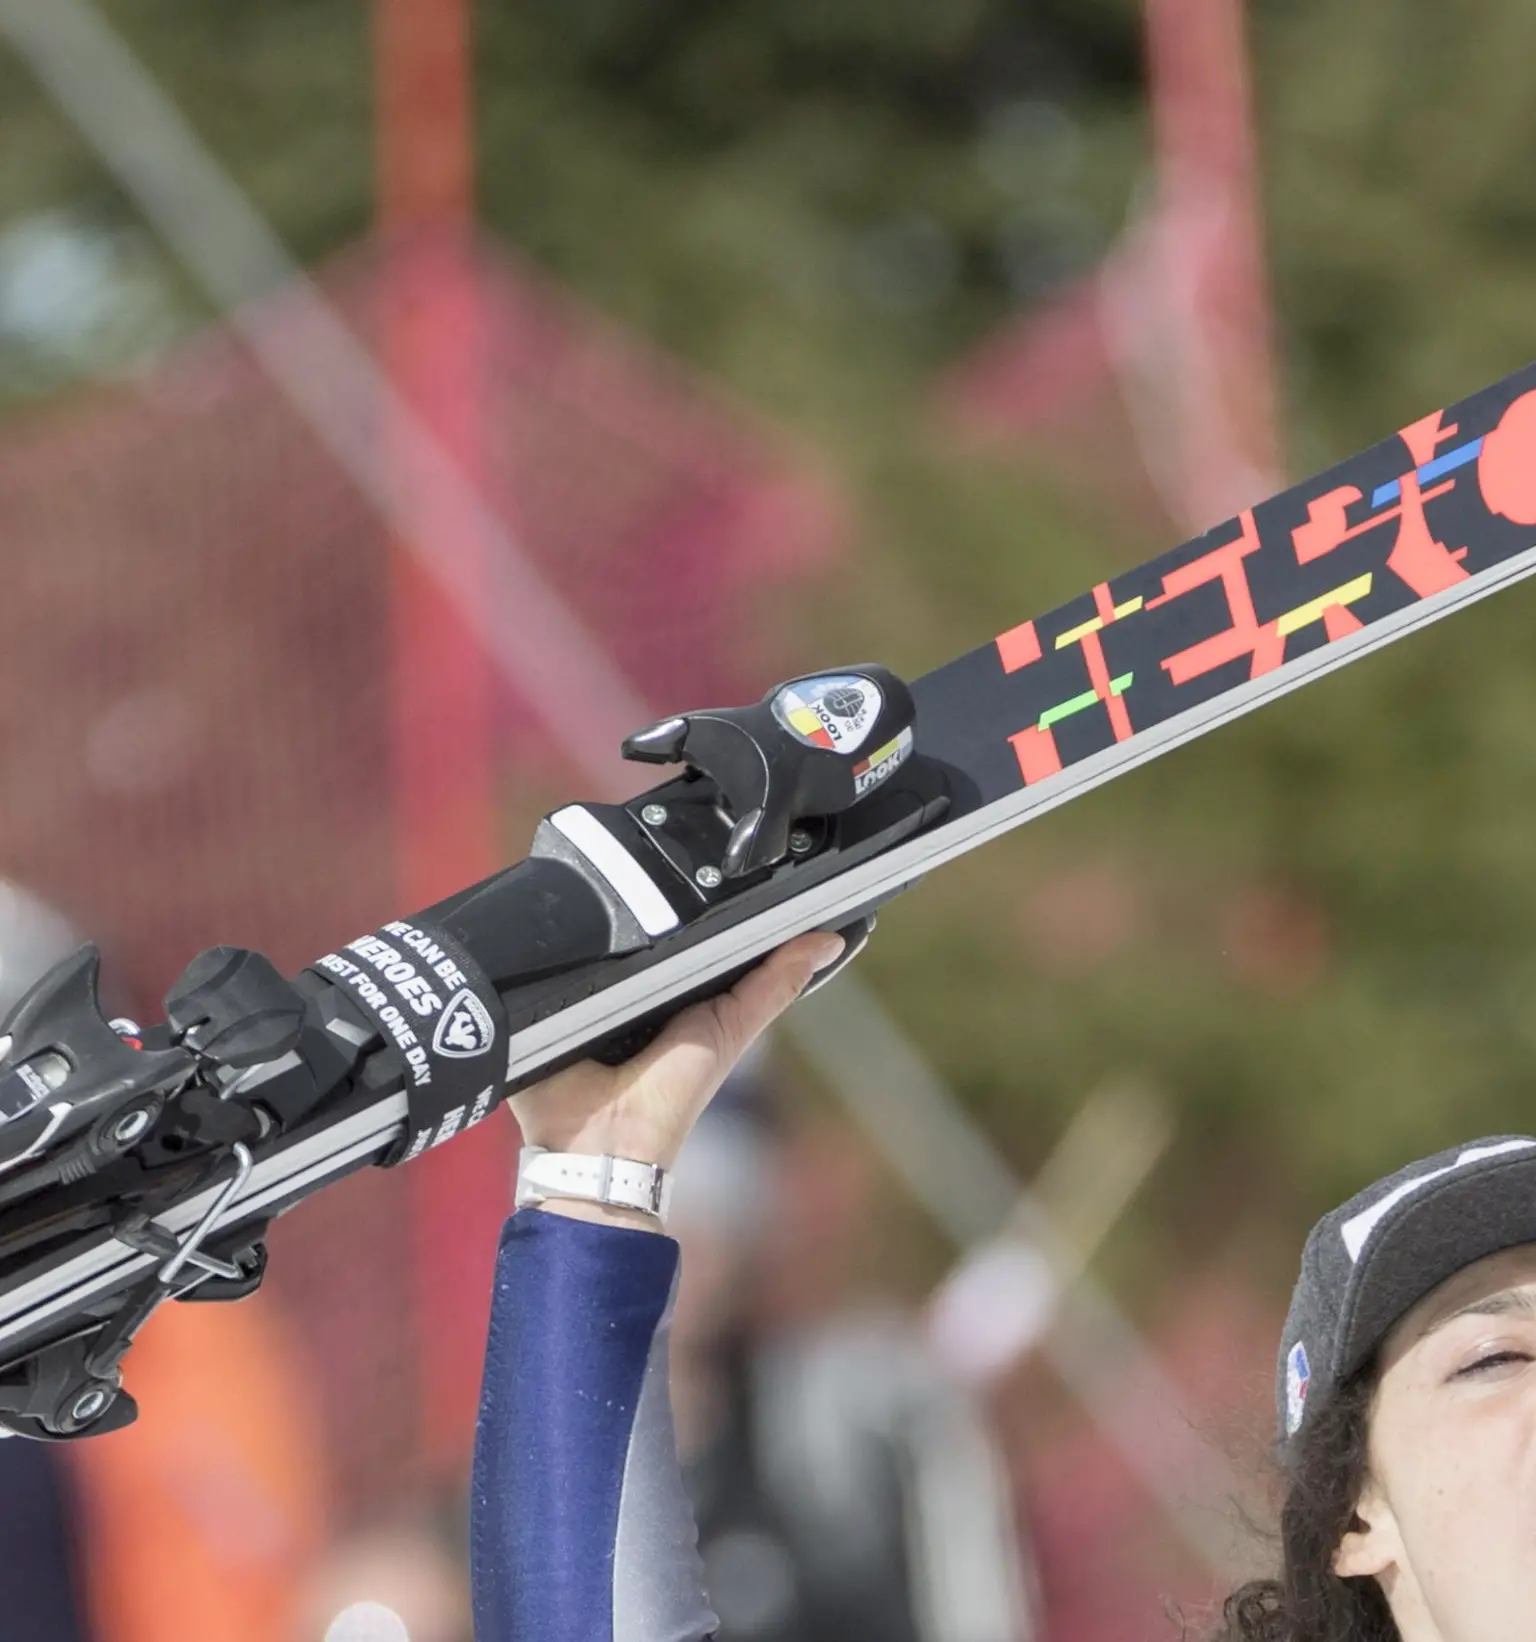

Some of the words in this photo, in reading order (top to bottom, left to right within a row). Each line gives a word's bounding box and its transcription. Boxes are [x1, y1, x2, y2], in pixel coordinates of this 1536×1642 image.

[811, 704, 843, 741] LOOK
[855, 750, 900, 795] LOOK
[402, 929, 446, 965] CAN
[433, 958, 468, 991] BE
[348, 972, 388, 1010] FOR
[379, 1005, 418, 1050] ONE
[405, 1046, 432, 1086] DAY
